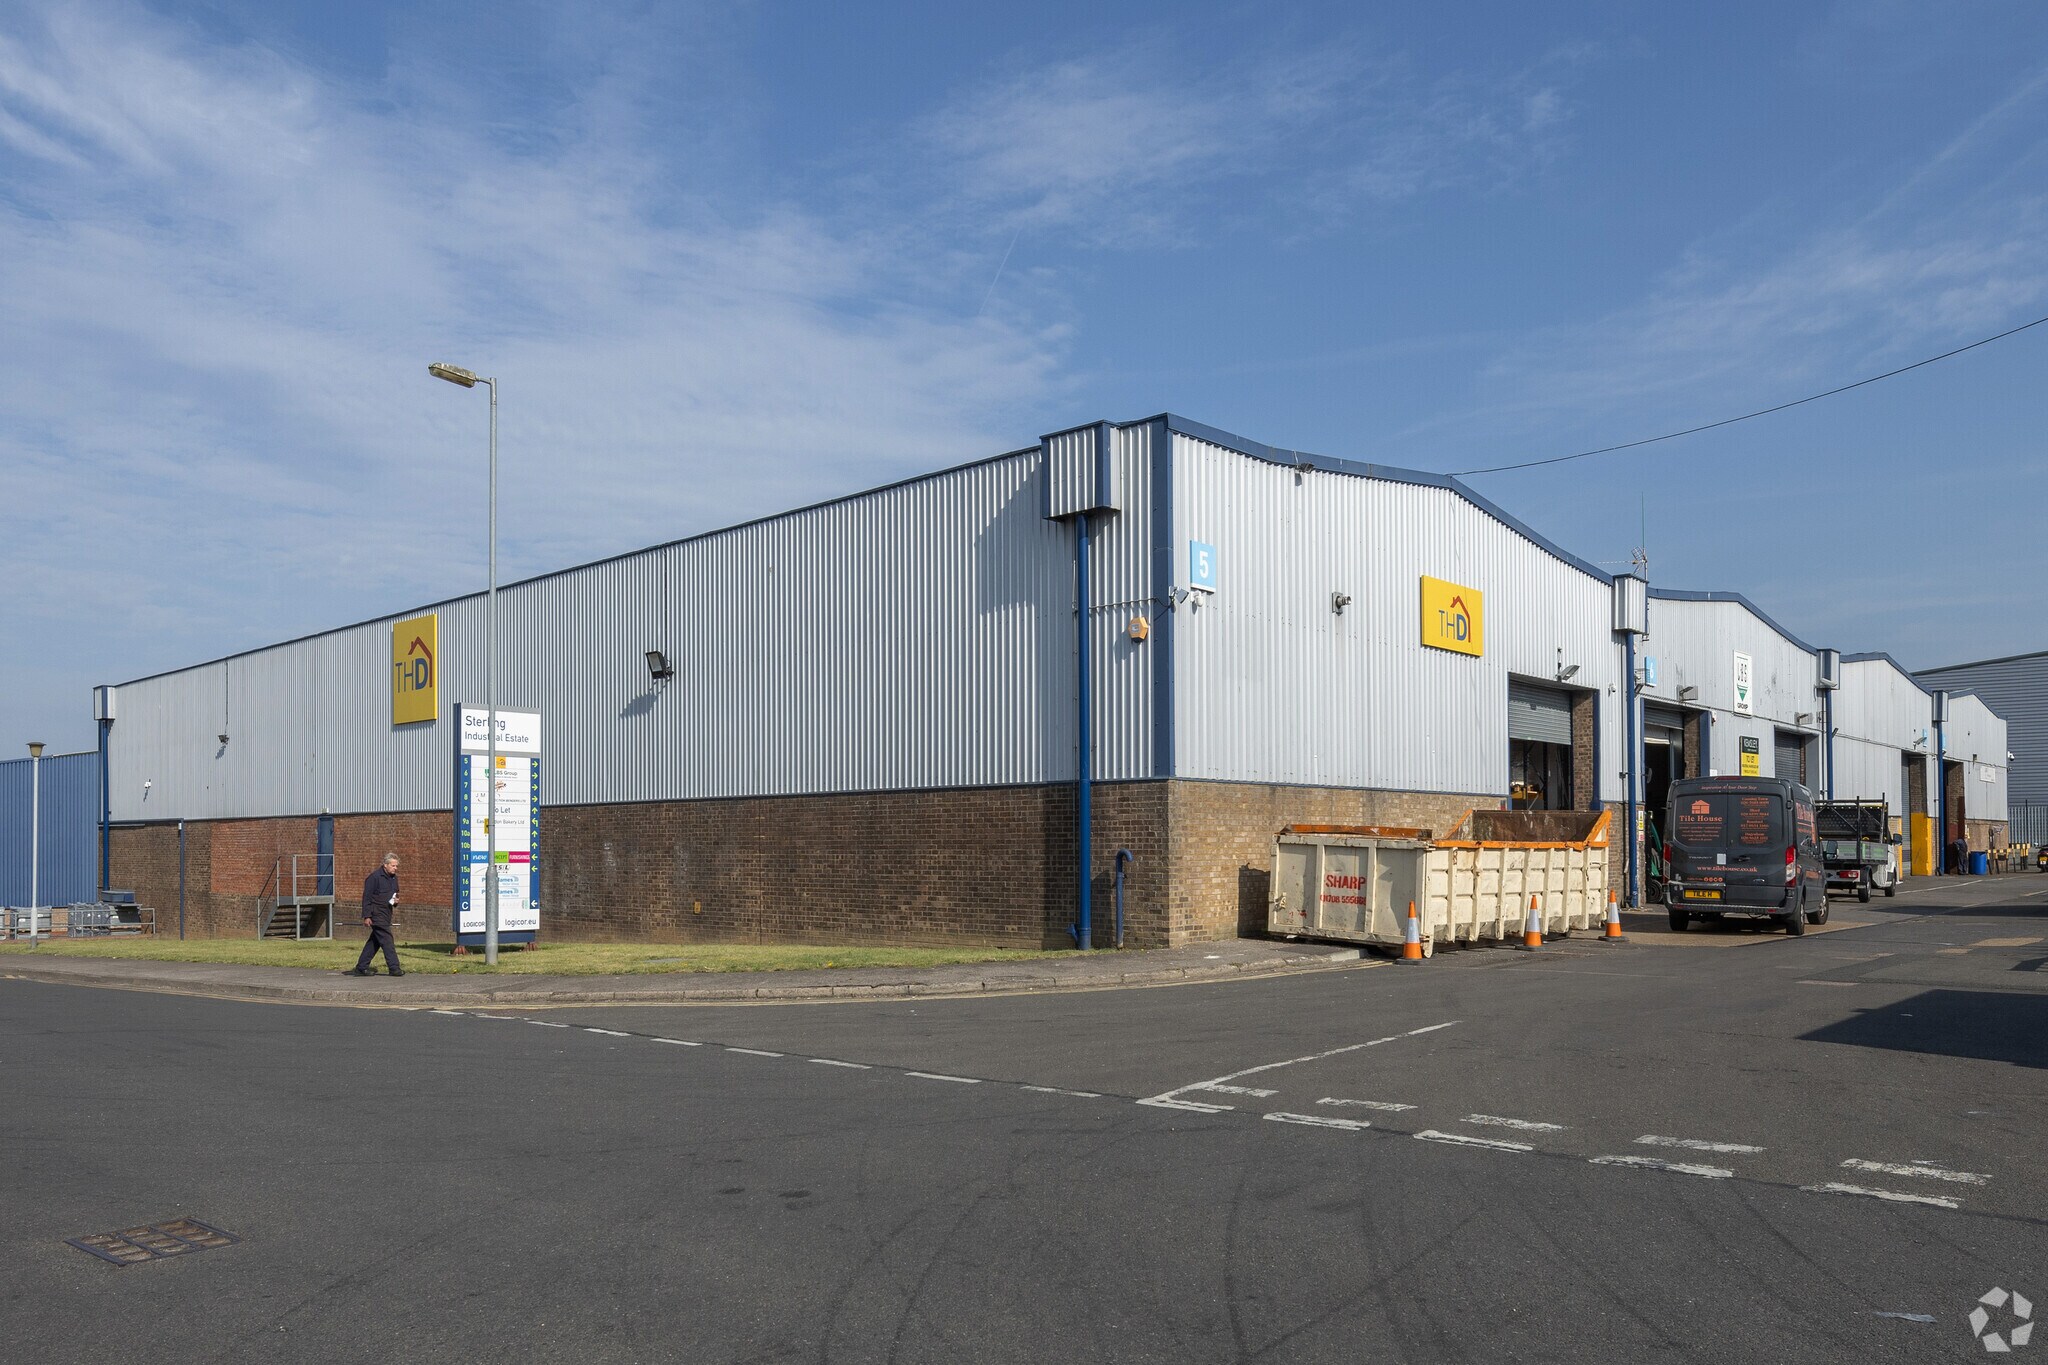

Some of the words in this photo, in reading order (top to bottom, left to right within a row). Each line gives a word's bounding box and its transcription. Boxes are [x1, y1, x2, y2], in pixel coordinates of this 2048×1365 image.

[1199, 550, 1209, 579] 5
[1438, 609, 1468, 642] THD
[395, 657, 429, 694] THD
[466, 715, 506, 730] Sterlng
[464, 731, 503, 742] Industal
[505, 733, 529, 743] Estate
[464, 757, 469, 765] 5
[464, 793, 469, 801] 8
[1325, 874, 1366, 890] SHARP
[461, 902, 469, 910] C
[504, 918, 537, 928] logicor.eu
